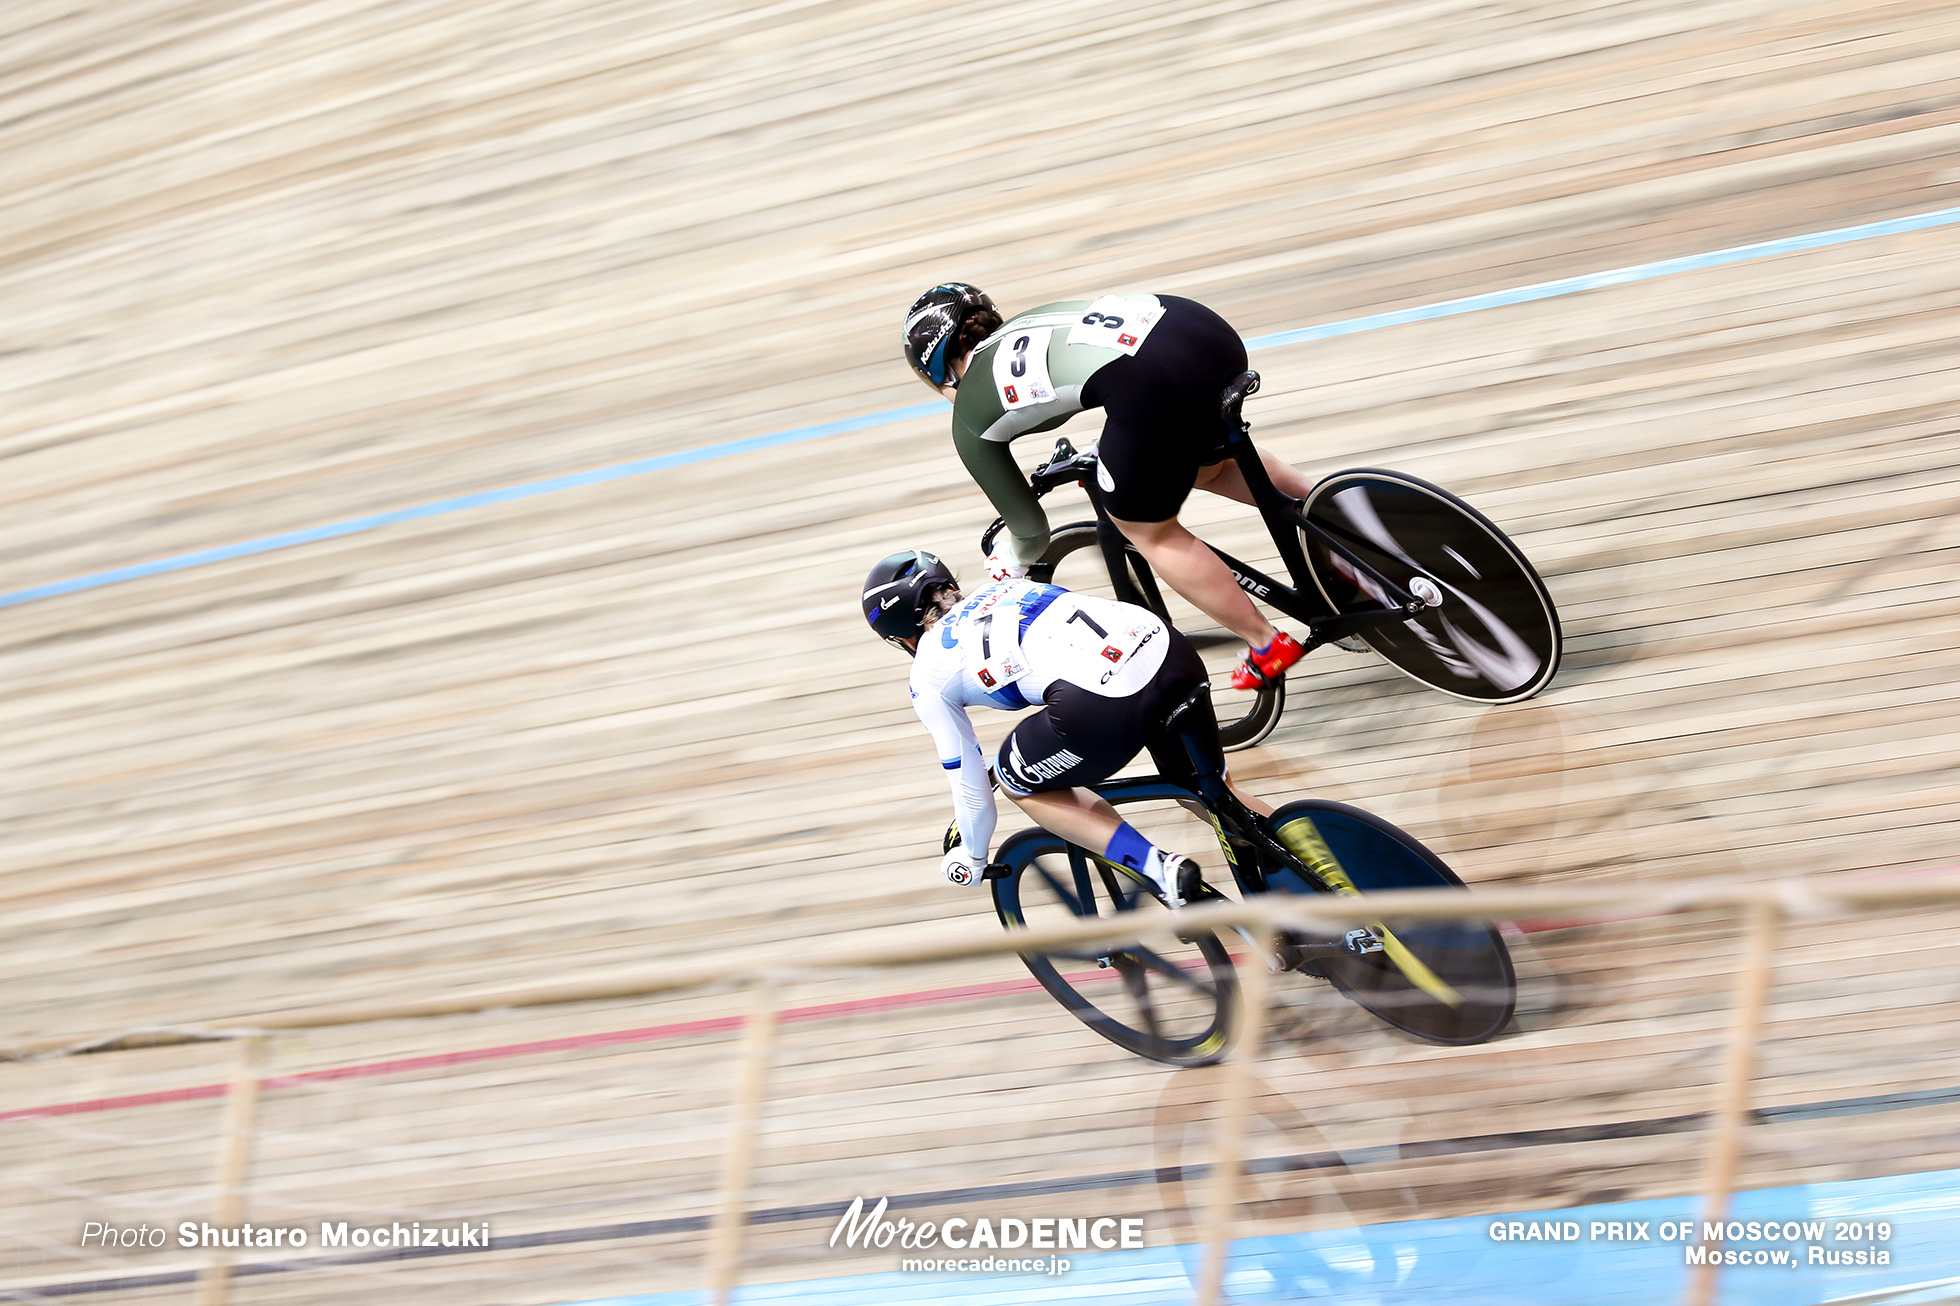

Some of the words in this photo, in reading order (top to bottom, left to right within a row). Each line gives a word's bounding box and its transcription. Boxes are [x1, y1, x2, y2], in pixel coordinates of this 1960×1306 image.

[1082, 312, 1124, 329] 3
[920, 319, 954, 365] Kabuto
[1010, 335, 1030, 377] 3
[973, 614, 993, 660] 7
[1066, 609, 1109, 640] 7
[1031, 748, 1084, 780] GAZPROM
